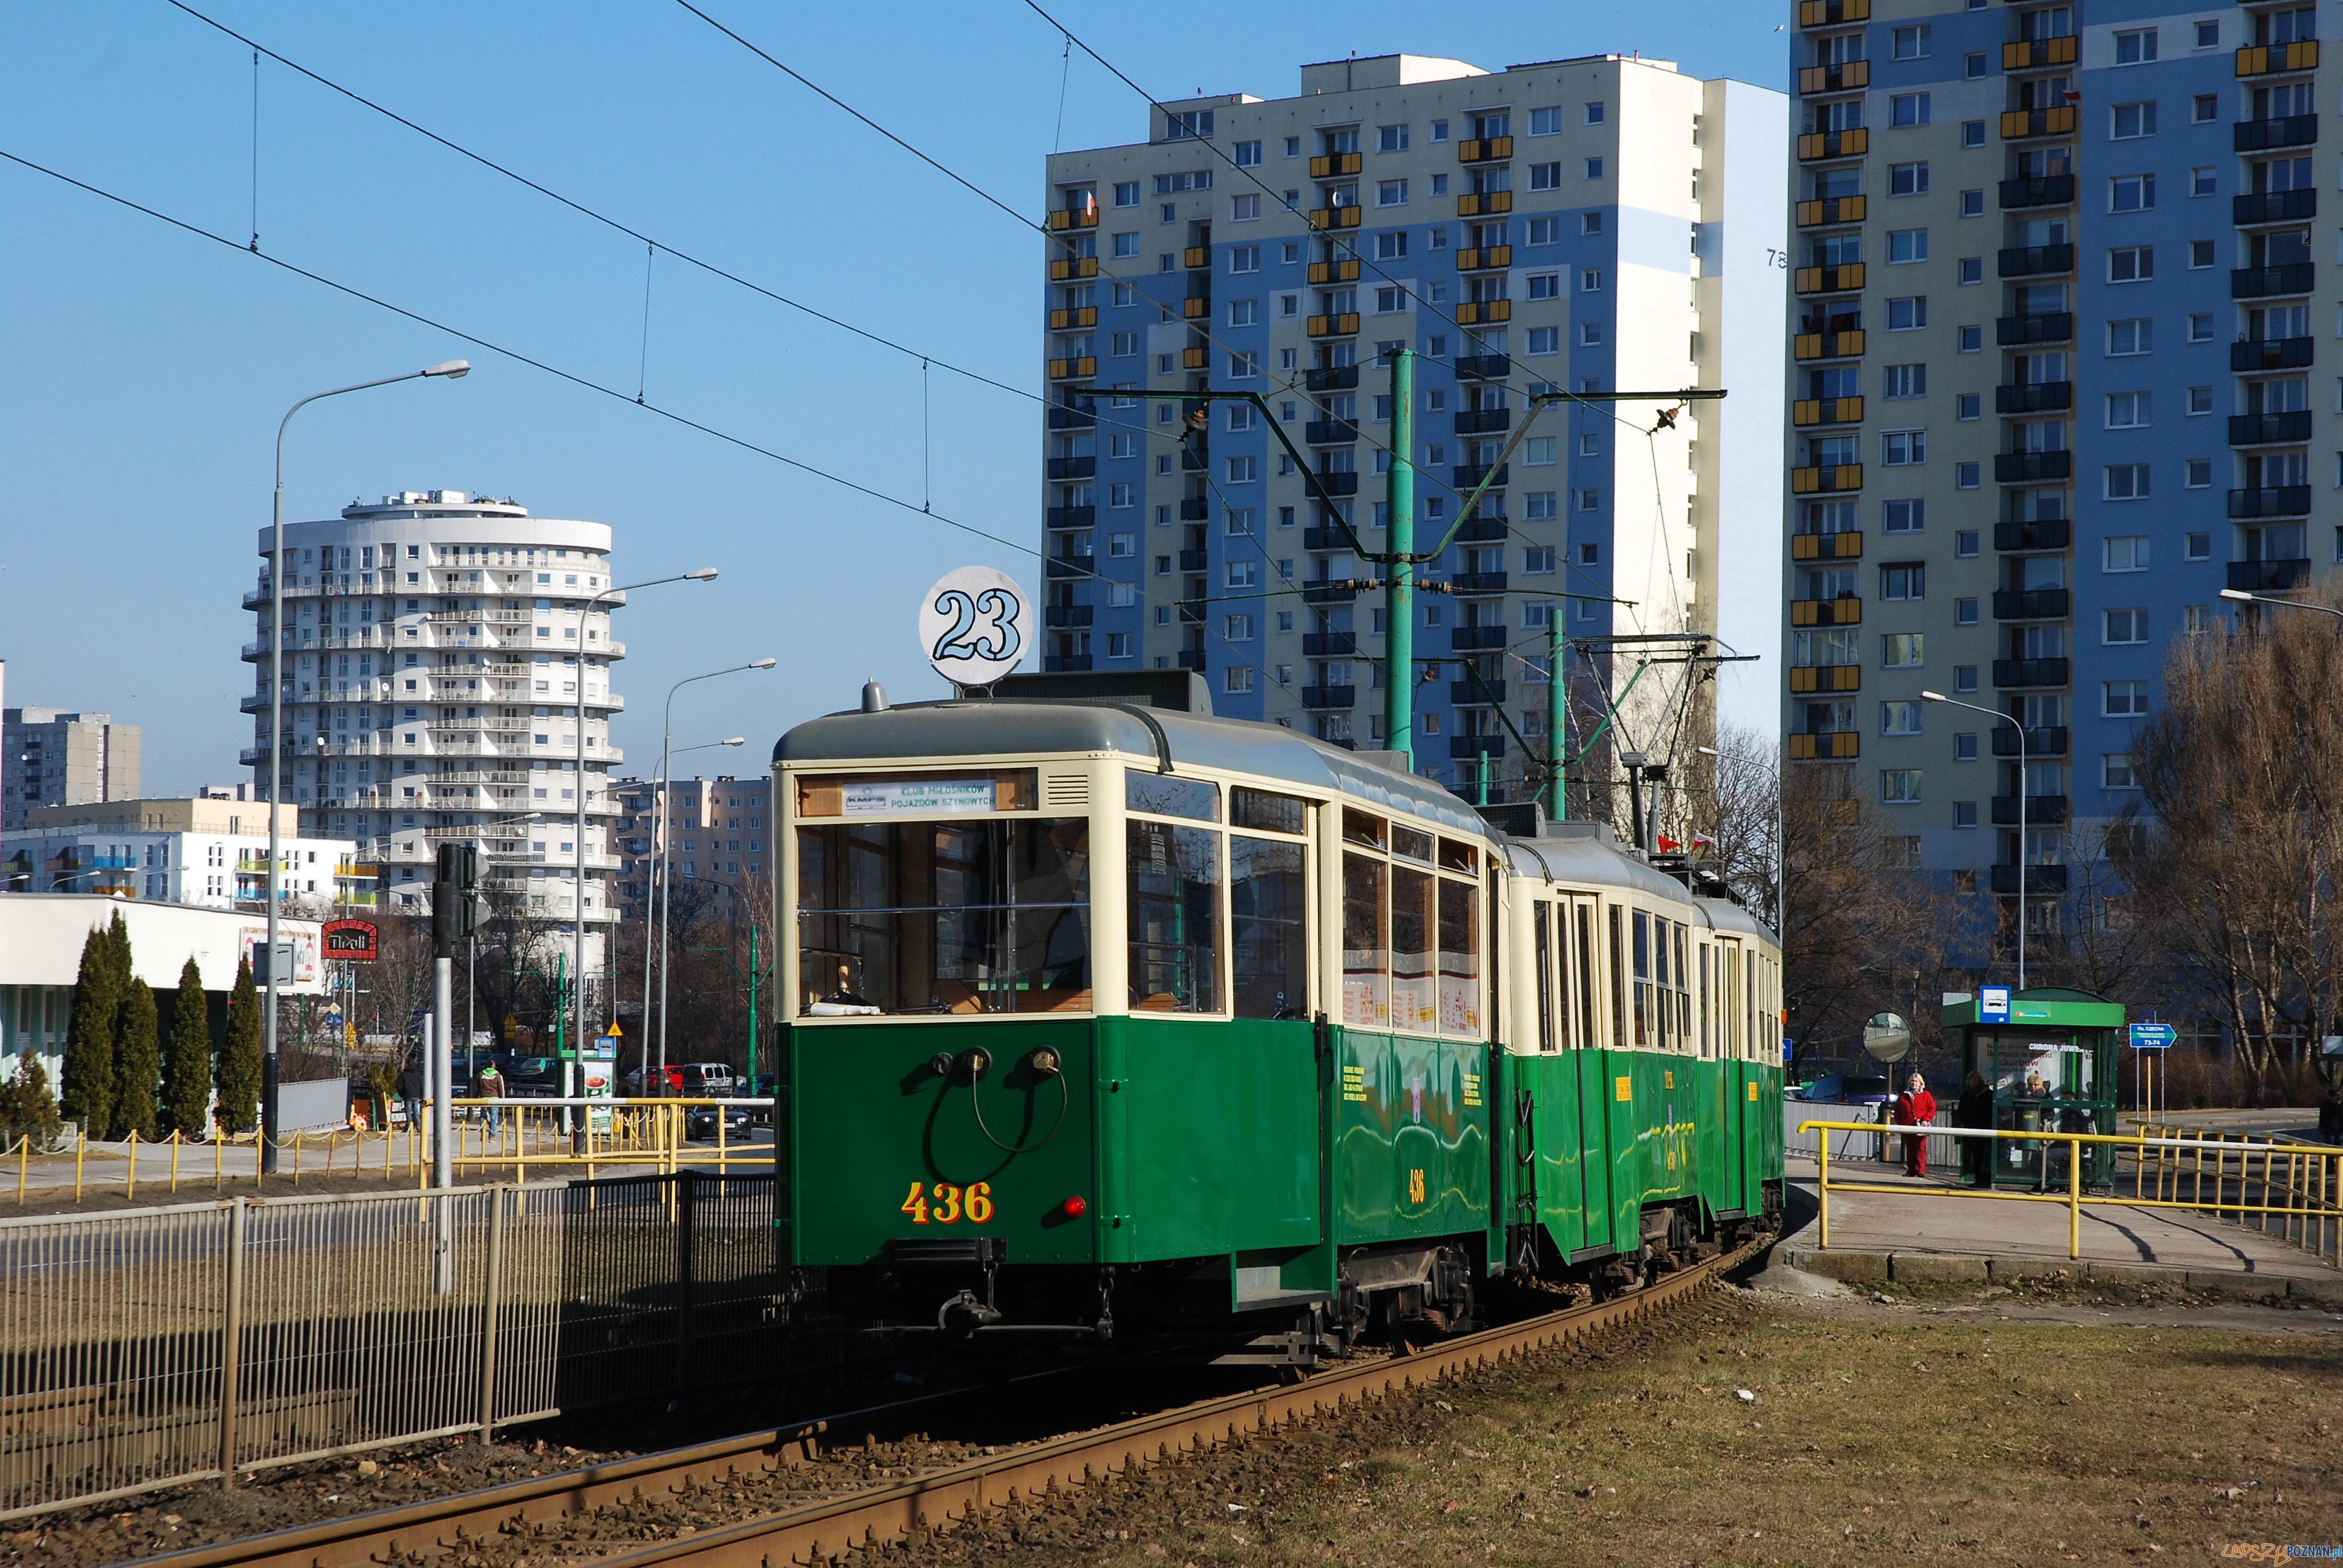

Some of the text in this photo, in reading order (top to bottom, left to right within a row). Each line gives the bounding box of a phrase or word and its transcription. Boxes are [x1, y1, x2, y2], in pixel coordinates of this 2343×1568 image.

[1766, 247, 1788, 269] 78
[932, 587, 1021, 662] 23
[900, 783, 985, 796] KLUB MIŁOŚNIKÓW
[891, 796, 995, 808] POJAZDÓW SZYNOWYCH
[327, 935, 365, 950] Tivoli
[1409, 1168, 1425, 1204] 436
[901, 1181, 995, 1224] 436
